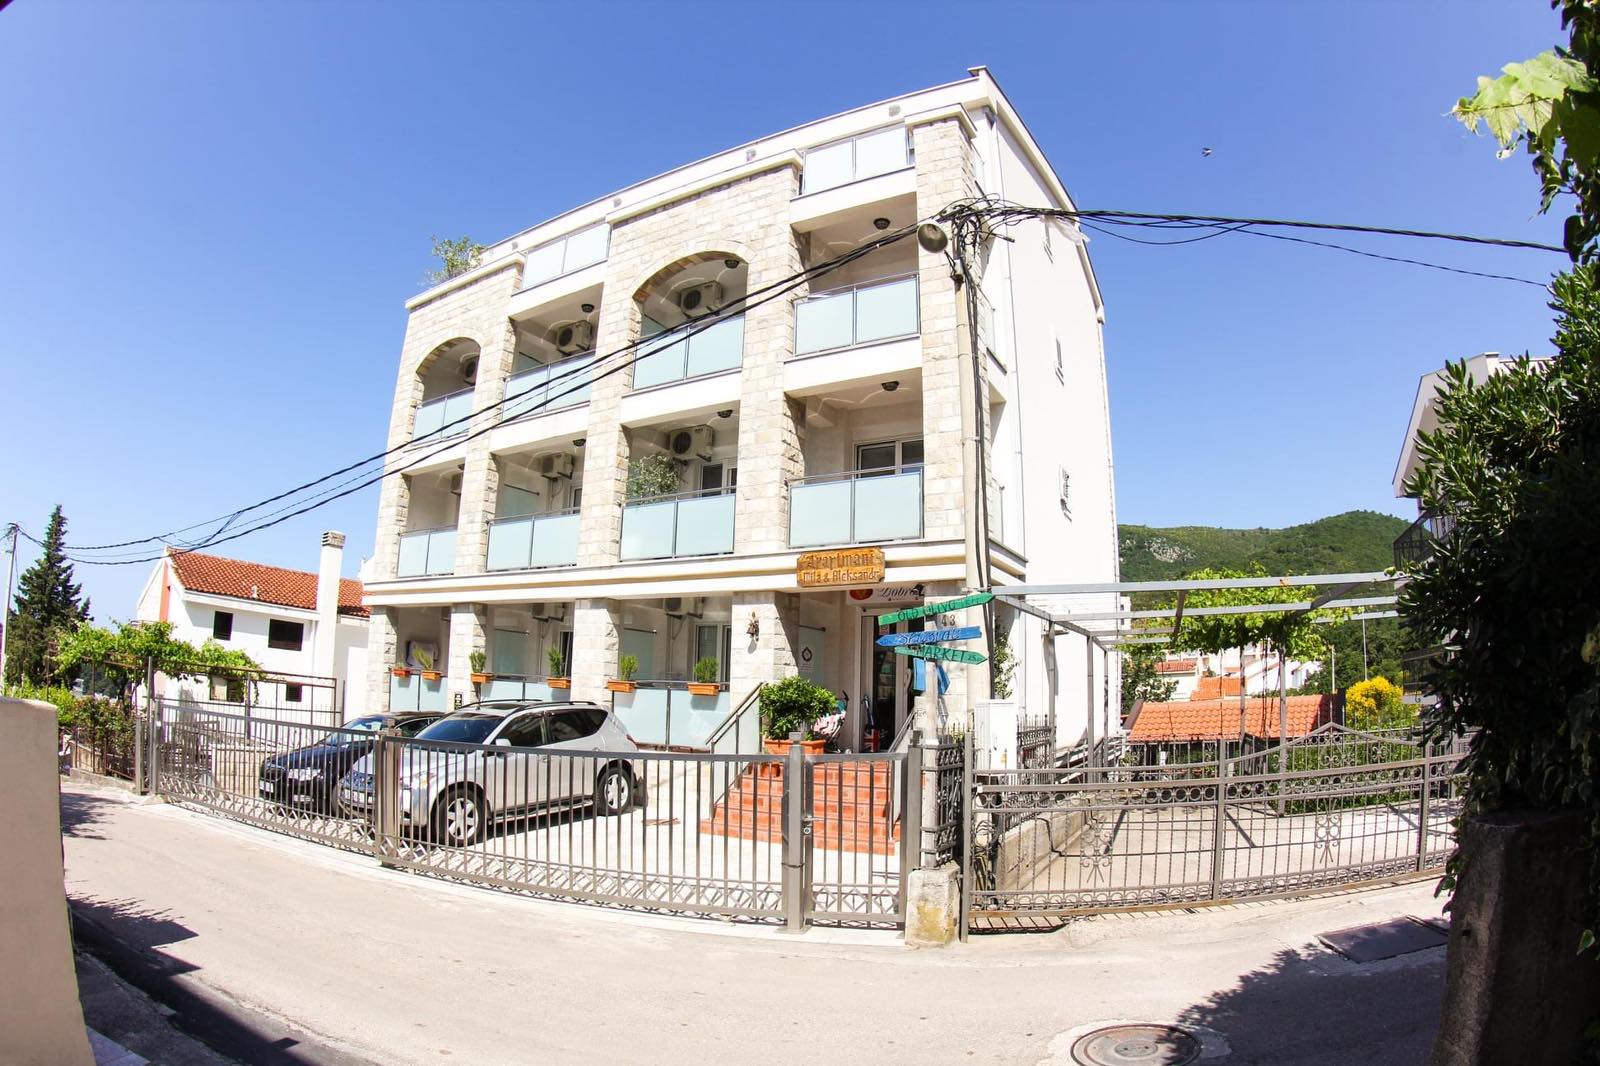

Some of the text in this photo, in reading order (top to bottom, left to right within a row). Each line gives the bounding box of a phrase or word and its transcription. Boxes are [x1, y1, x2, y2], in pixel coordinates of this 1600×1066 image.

[898, 608, 919, 621] OLD
[942, 614, 956, 627] 43
[916, 644, 968, 662] MARKET
